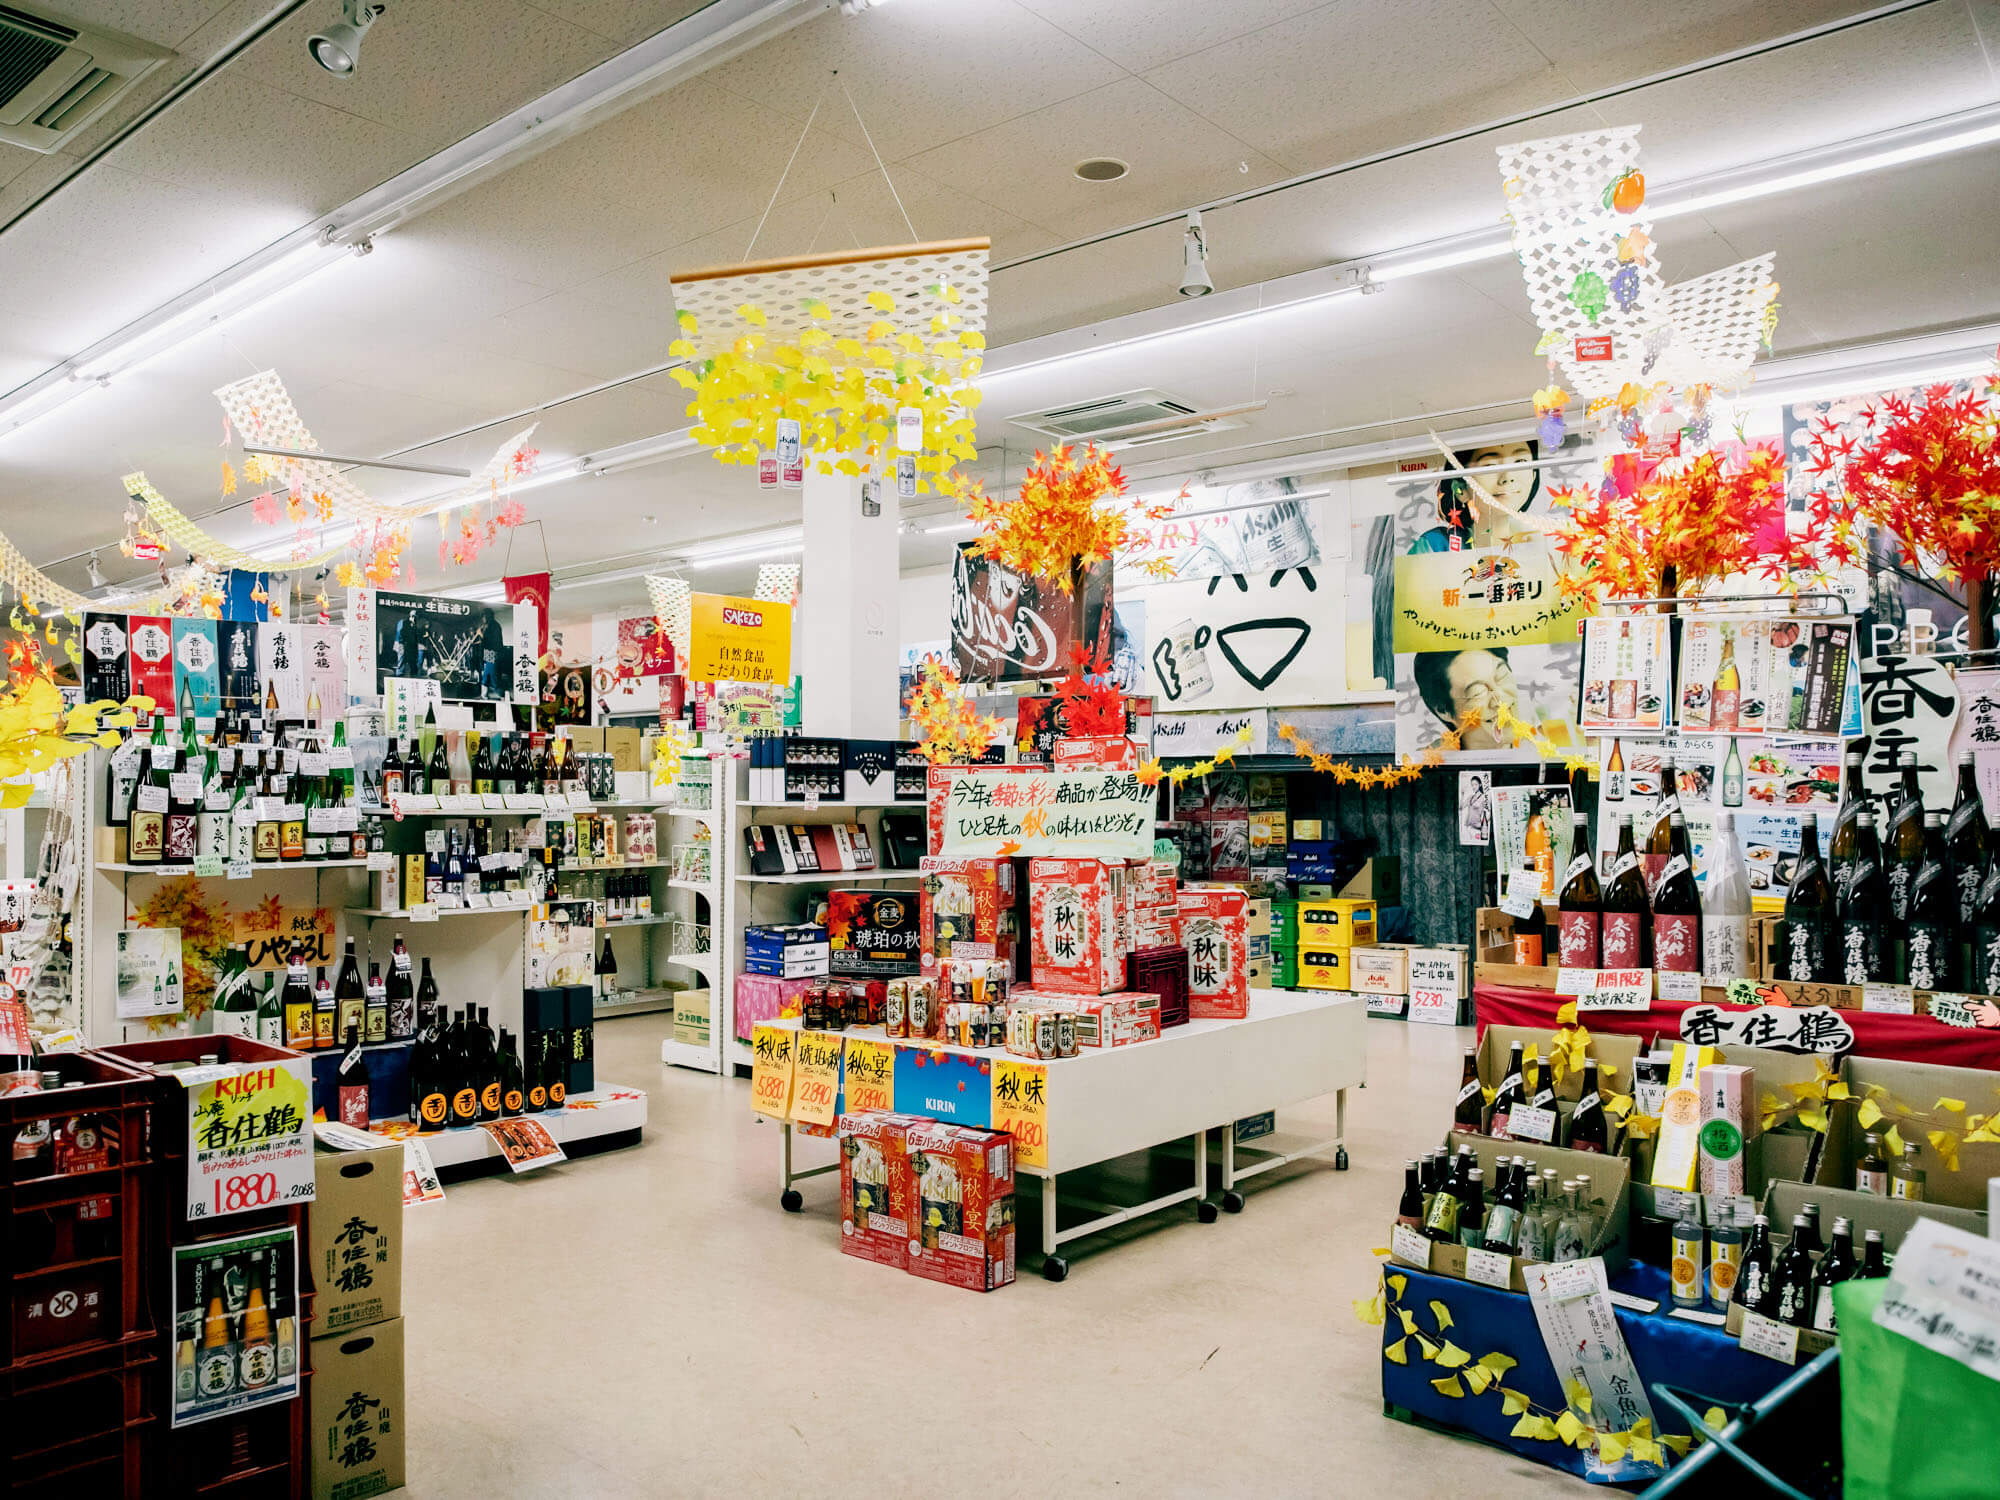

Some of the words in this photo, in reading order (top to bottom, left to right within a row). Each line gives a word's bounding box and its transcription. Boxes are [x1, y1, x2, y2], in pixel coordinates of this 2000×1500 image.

[779, 436, 798, 445] Asahi
[1401, 462, 1428, 472] KIRIN
[1241, 500, 1299, 543] Asahi
[1266, 534, 1286, 553] 生
[723, 608, 762, 627] SAKEZO
[100, 626, 115, 657] 香住鶴
[145, 629, 158, 658] 香住鶴
[190, 637, 203, 667] 香住鶴
[719, 646, 765, 663] 自然食品
[515, 654, 537, 694] 香住鶴
[706, 663, 774, 681] こだわり食品
[1153, 721, 1186, 737] Asahi
[1684, 740, 1714, 750] からくち
[291, 914, 319, 932] 純米
[878, 907, 900, 919] 金麦
[976, 890, 995, 938] 秋の宴
[855, 929, 921, 949] 琥珀の秋
[1053, 905, 1077, 960] 秋味
[1190, 937, 1219, 988] 秋味
[1788, 923, 1811, 982] 香住鶴
[1843, 925, 1869, 985] 香住鶴
[1908, 929, 1935, 990] 香住鶴
[1414, 990, 1443, 1008] 5230
[1794, 985, 1851, 1005] 大分県
[886, 998, 899, 1023] 秋味
[912, 999, 926, 1023] 秋味
[1060, 1027, 1073, 1049] 秋味
[1682, 1006, 1850, 1051] 香住鶴
[756, 1034, 791, 1064] 秋味
[846, 1050, 892, 1078] 秋の宴
[215, 1067, 276, 1099] RICH
[800, 1081, 832, 1105] 2890
[995, 1071, 1044, 1105] 秋味
[925, 1097, 956, 1114] KIRIN
[197, 1103, 304, 1150] 香住鶴
[907, 1132, 955, 1153] 6缶パック×4
[888, 1160, 906, 1213] 秋の宴
[963, 1177, 983, 1232] 秋の宴
[333, 1215, 379, 1294] 香住鶴
[83, 1291, 99, 1306] 酒
[208, 1358, 228, 1391] 香住鶴
[248, 1349, 268, 1380] 香住鶴
[1608, 1375, 1641, 1418] 金魚
[335, 1391, 381, 1470] 香住鶴
